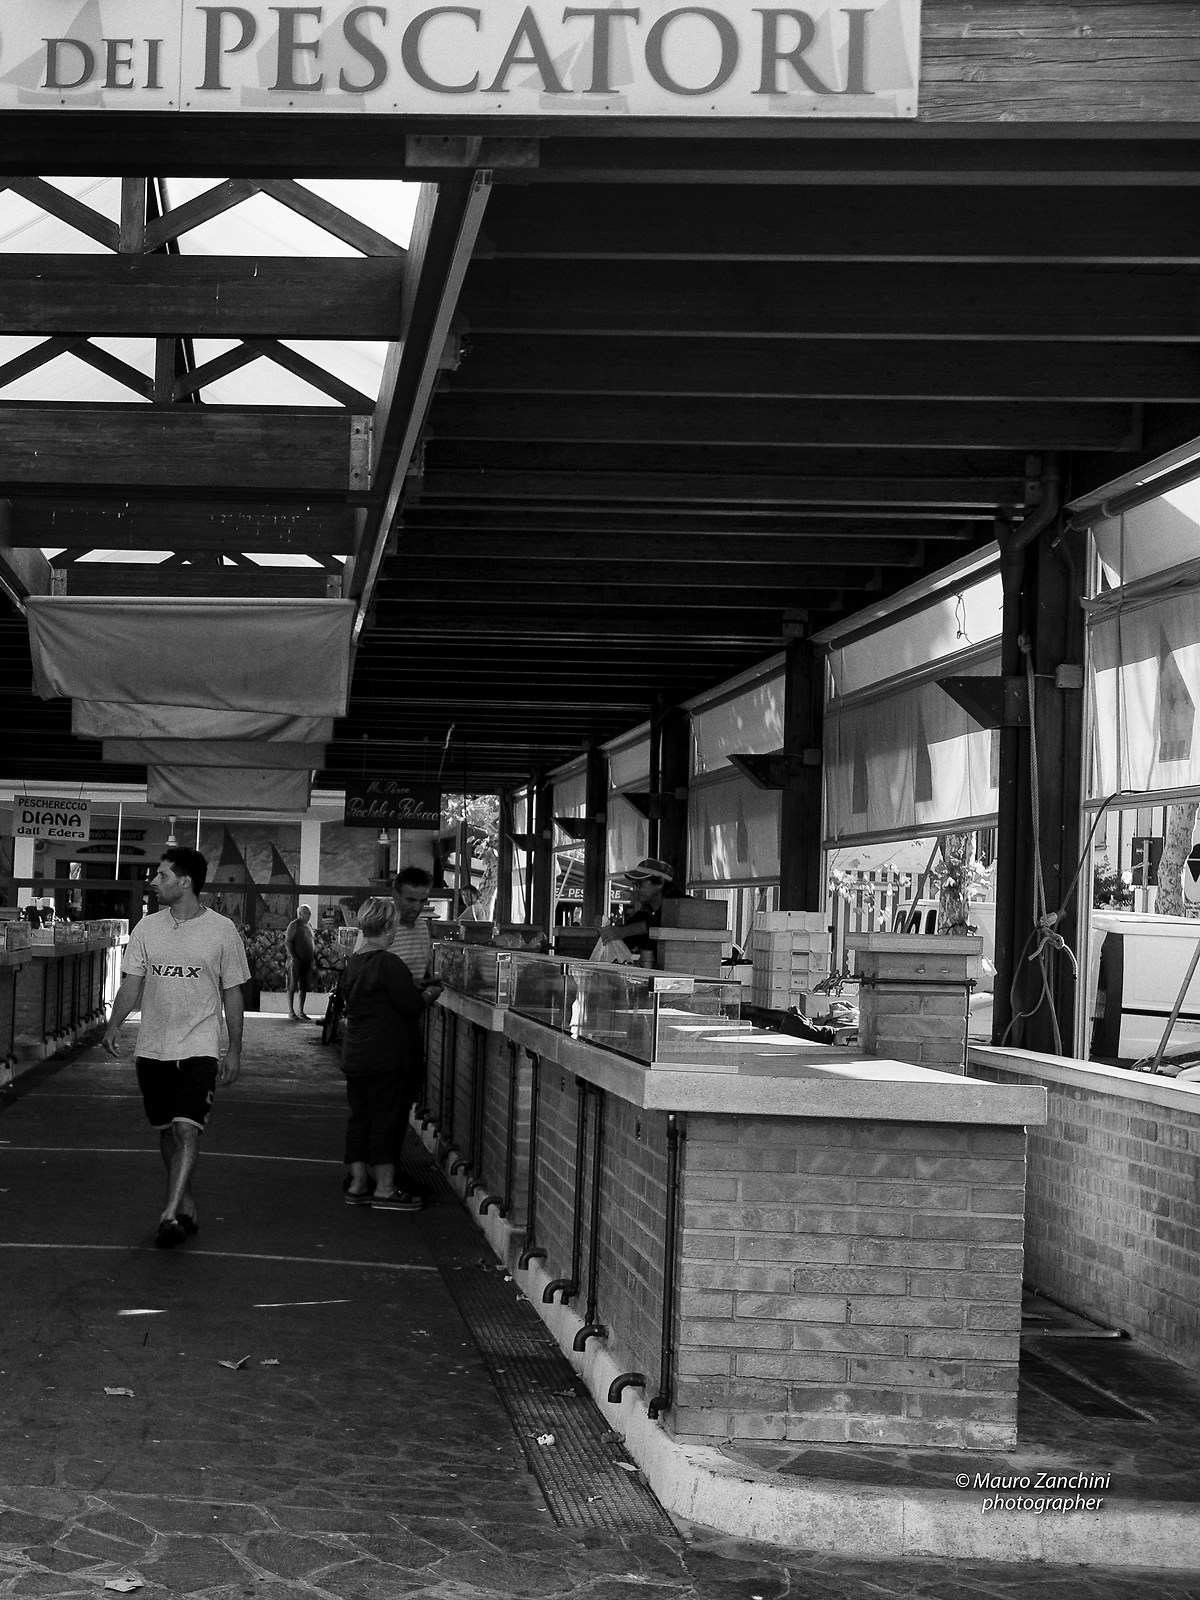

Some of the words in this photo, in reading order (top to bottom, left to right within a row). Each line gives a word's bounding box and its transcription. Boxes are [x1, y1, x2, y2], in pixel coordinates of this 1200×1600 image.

[40, 38, 164, 89] DEI
[195, 5, 875, 95] PESCATORI
[18, 798, 87, 811] PESCHERECCIO
[22, 810, 82, 827] DIANA
[47, 828, 85, 839] Edera
